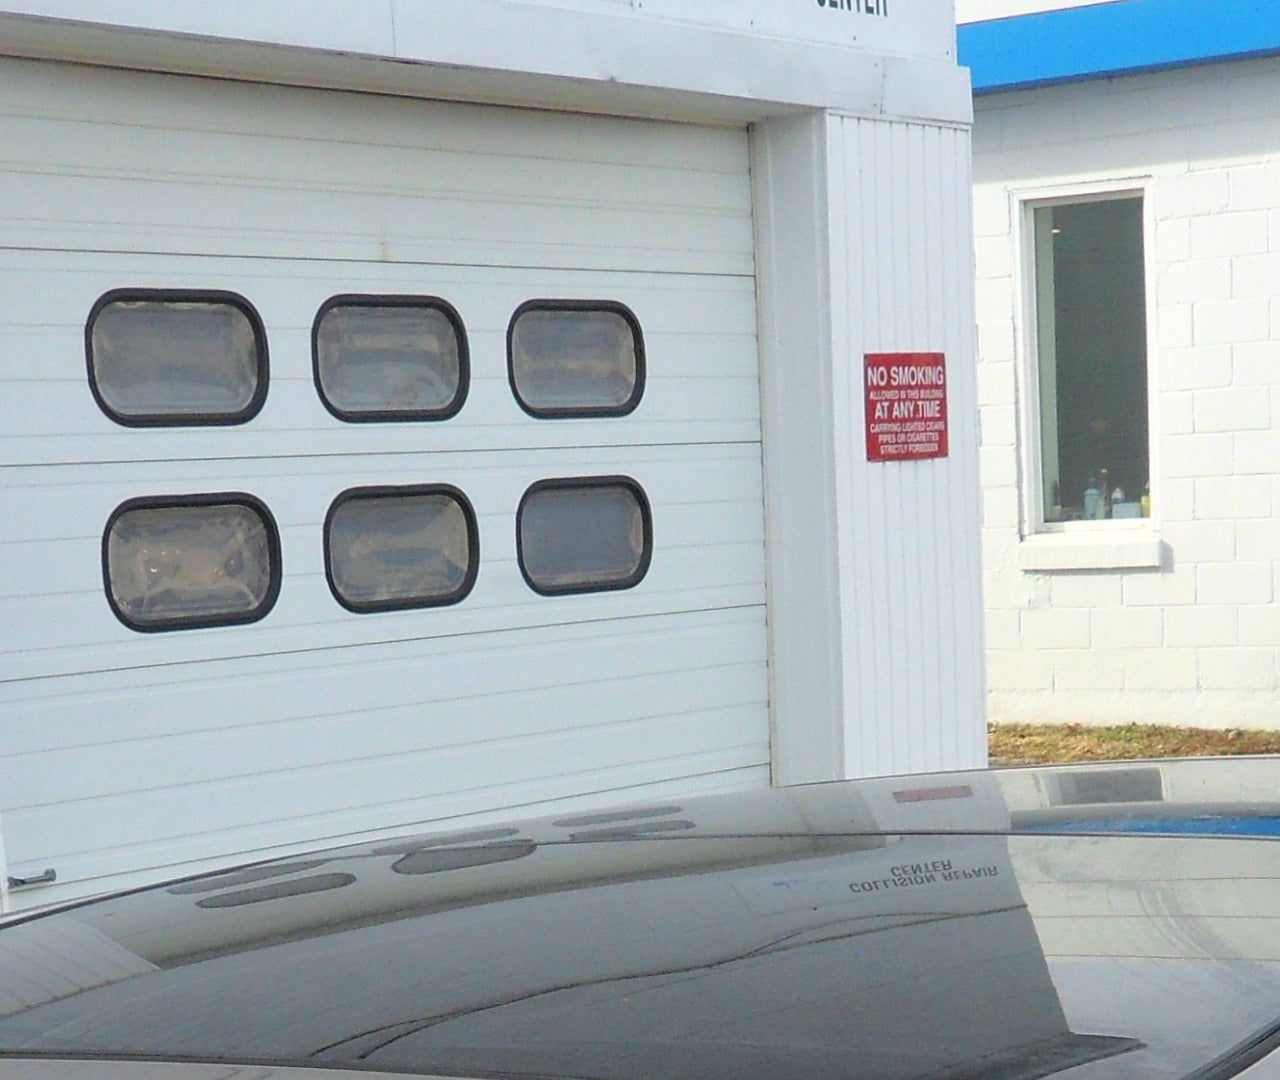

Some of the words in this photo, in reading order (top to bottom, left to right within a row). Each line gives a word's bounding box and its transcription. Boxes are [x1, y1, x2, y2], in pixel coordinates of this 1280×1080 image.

[867, 366, 888, 386] NO
[890, 365, 944, 386] SMOKING
[875, 402, 890, 419] AT
[892, 401, 915, 419] ANY
[917, 400, 941, 418] TIME
